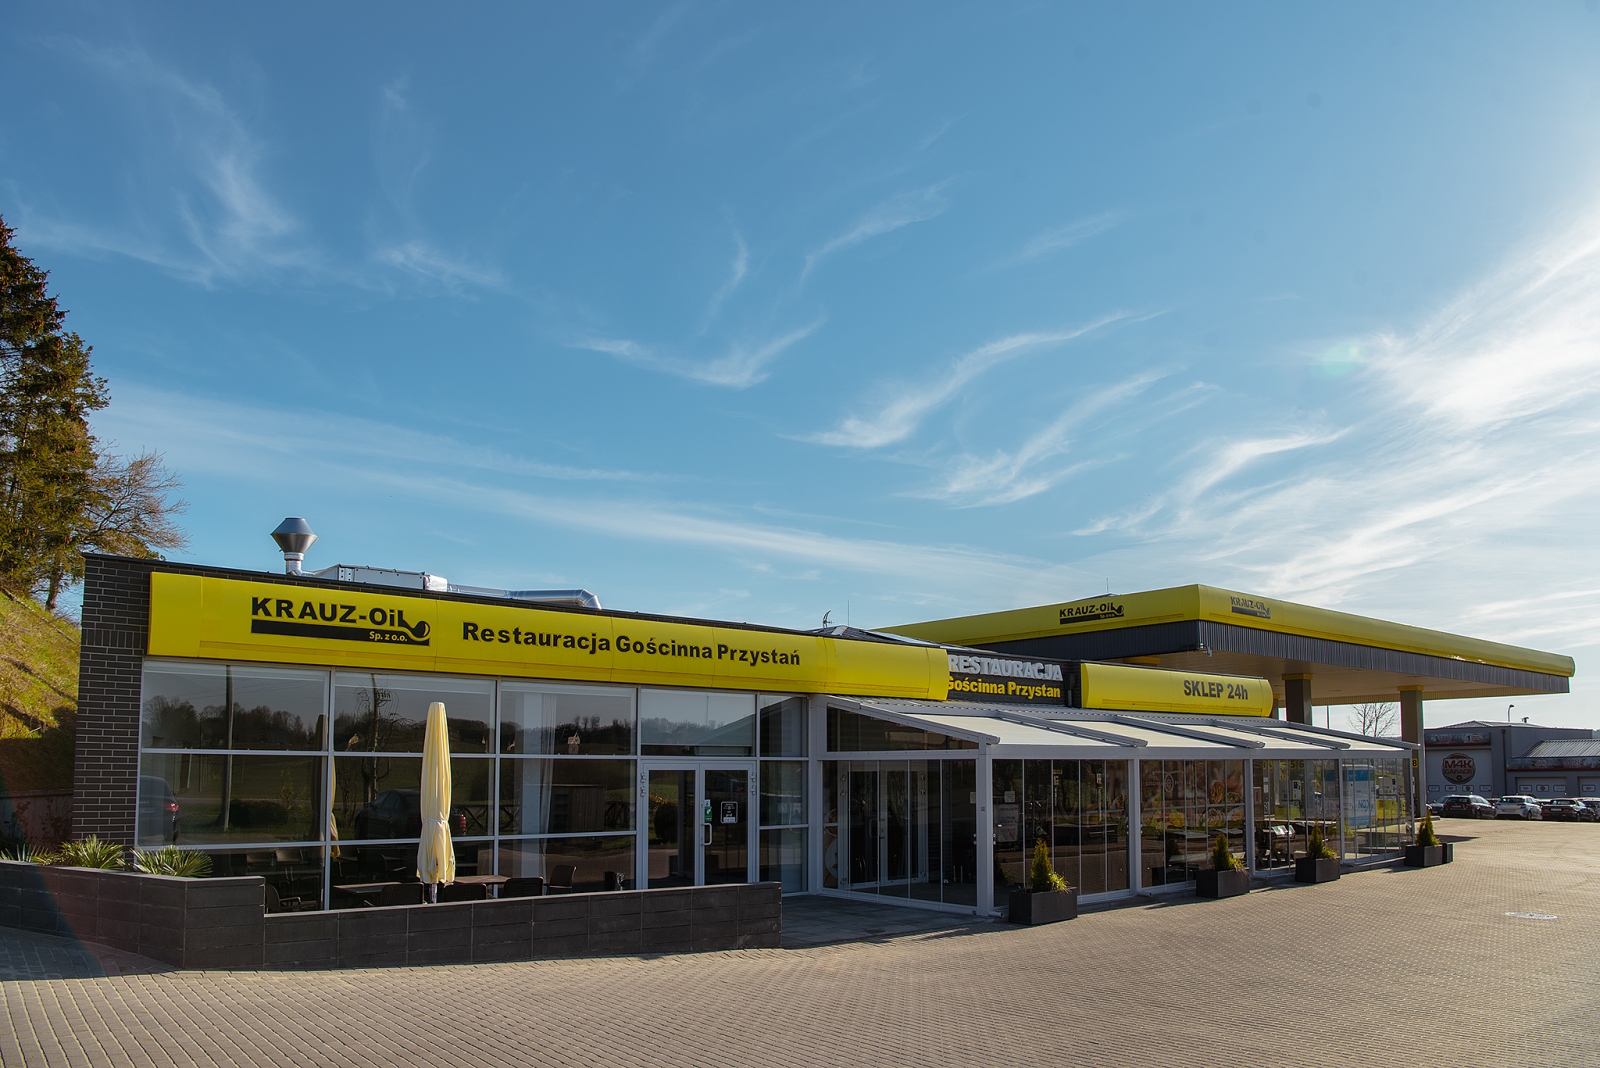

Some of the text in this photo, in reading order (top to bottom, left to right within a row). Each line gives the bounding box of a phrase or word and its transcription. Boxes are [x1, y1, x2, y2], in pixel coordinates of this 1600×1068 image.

[369, 631, 383, 641] Sp.
[391, 634, 407, 642] o.o.
[462, 622, 800, 666] Restauracja Gościnna Przystań
[947, 654, 1063, 681] RESTAURACJA
[1183, 680, 1248, 700] SKLEP 24h
[1290, 760, 1296, 768] 5
[1299, 760, 1305, 768] 6
[1444, 760, 1473, 768] M4K
